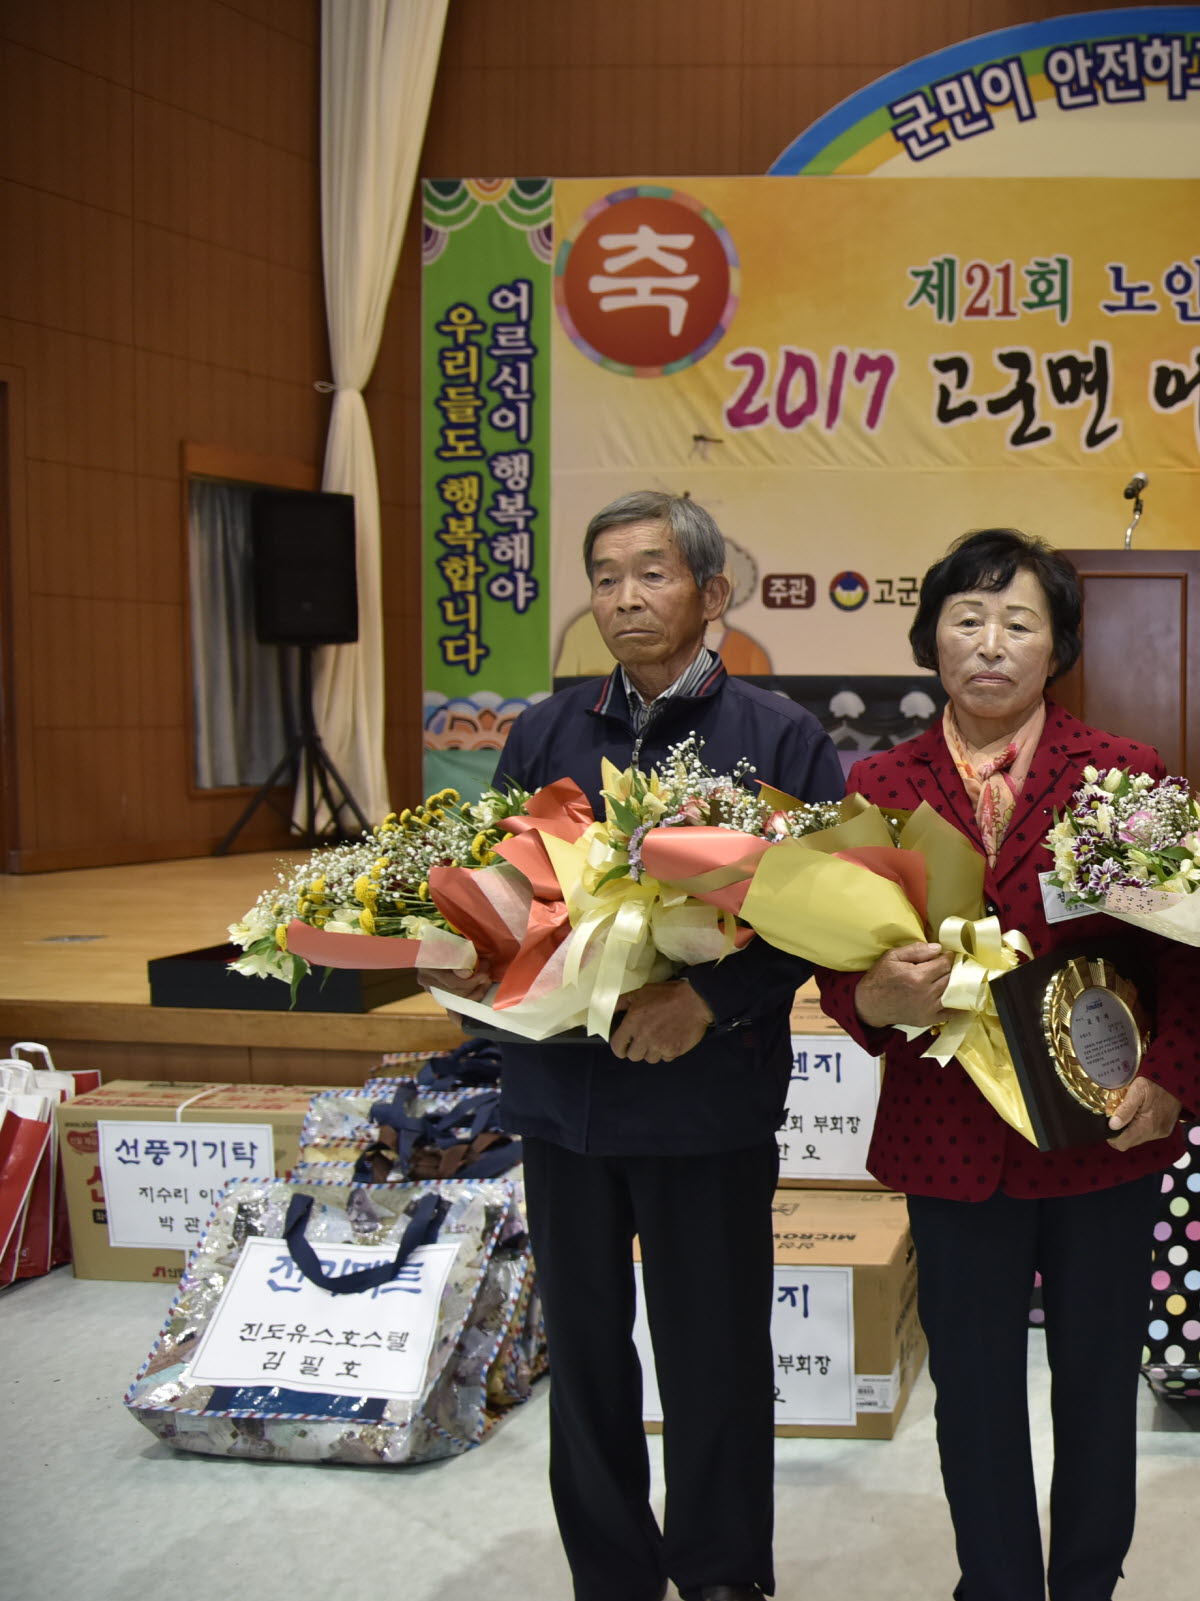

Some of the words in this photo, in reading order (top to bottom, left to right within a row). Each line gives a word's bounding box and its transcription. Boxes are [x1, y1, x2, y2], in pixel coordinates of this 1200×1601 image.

[889, 57, 1036, 160] 군민이
[589, 225, 700, 336] 축
[907, 256, 1070, 324] 제21회
[438, 304, 485, 459] 우리들도
[488, 280, 536, 443] 어르신이
[725, 351, 895, 430] 2017
[933, 345, 1118, 450] 고군면
[487, 450, 537, 612] 행복해야
[437, 473, 487, 673] 행복합니다
[768, 578, 809, 606] 주관
[114, 1138, 258, 1169] 선풍기기탁
[813, 1114, 861, 1135] 부회장
[138, 1186, 189, 1205] 지수리
[777, 1283, 810, 1319] 지
[240, 1322, 410, 1353] 진도유스호스텔
[777, 1354, 832, 1376] 부회장
